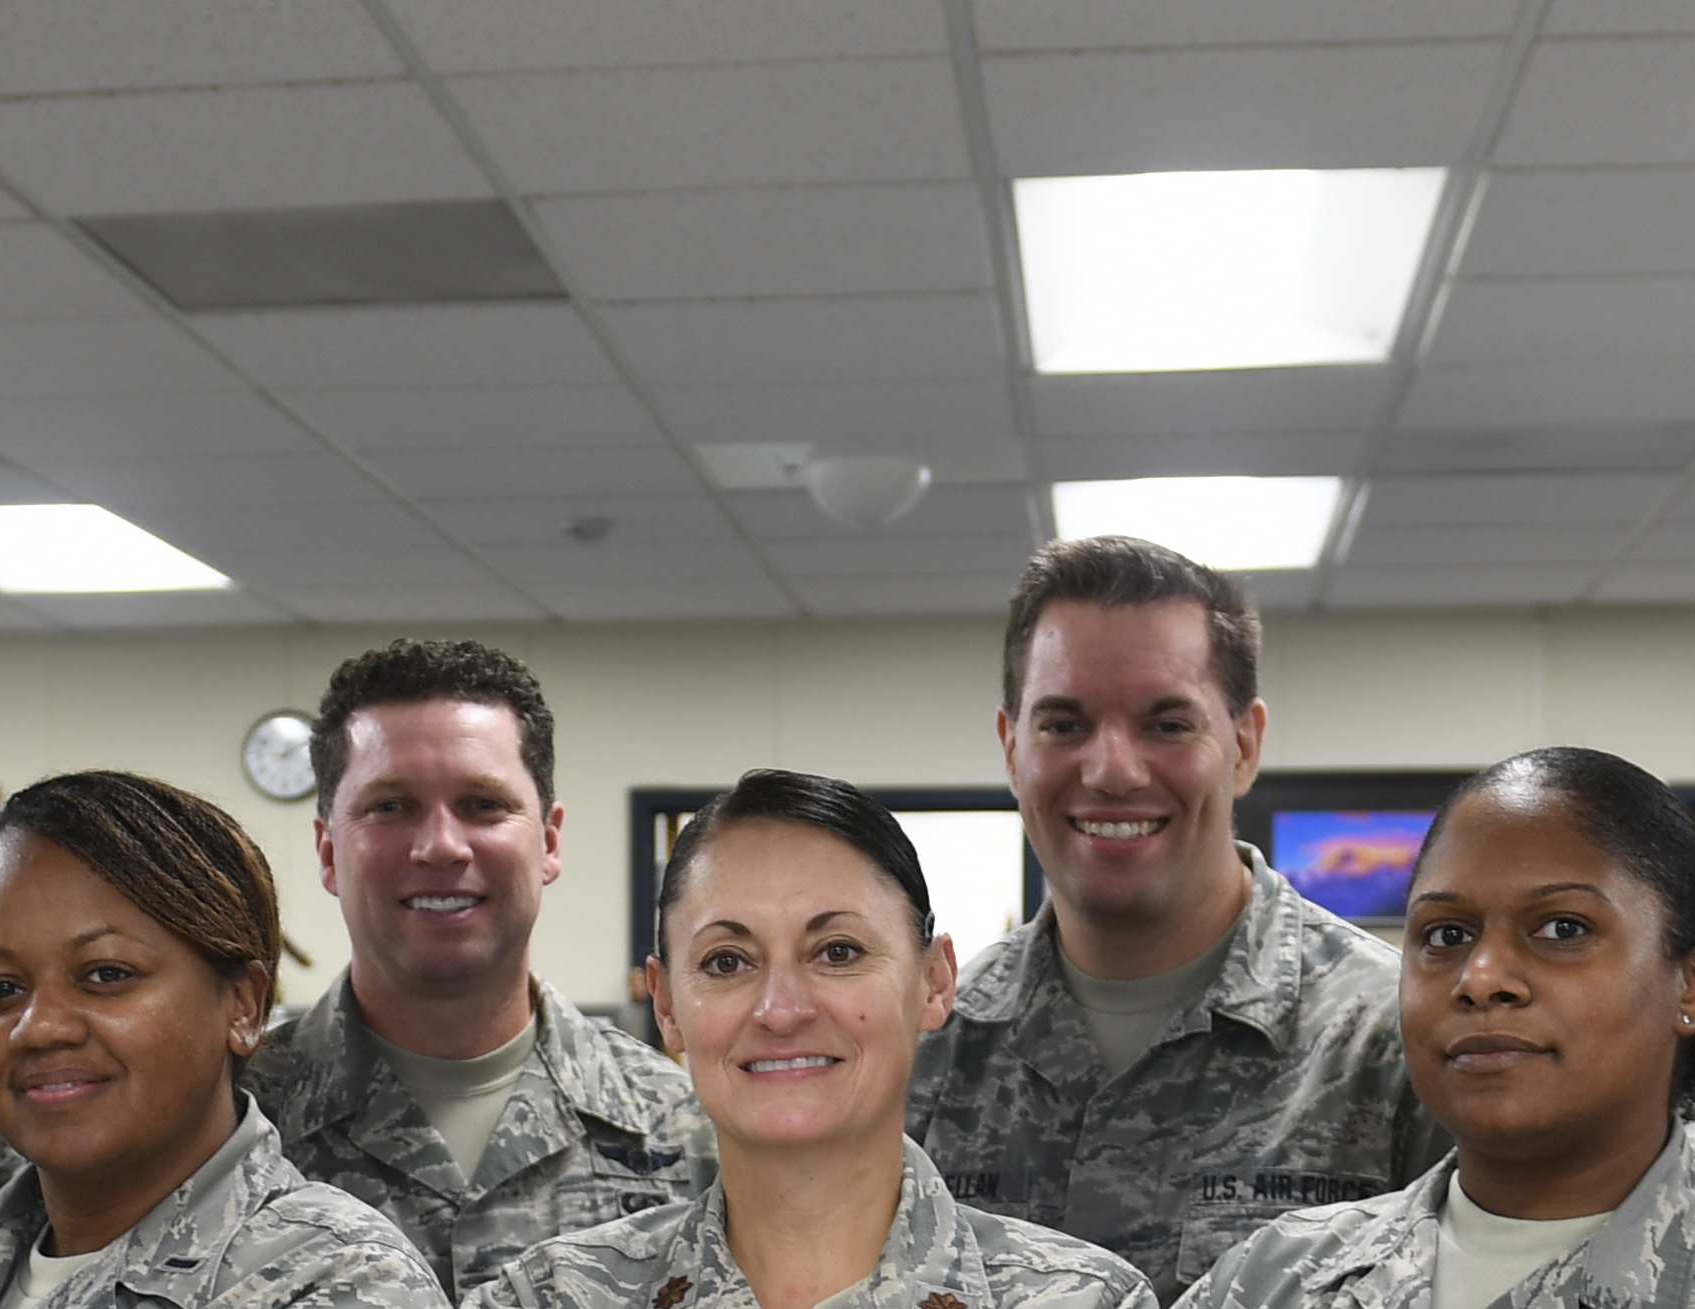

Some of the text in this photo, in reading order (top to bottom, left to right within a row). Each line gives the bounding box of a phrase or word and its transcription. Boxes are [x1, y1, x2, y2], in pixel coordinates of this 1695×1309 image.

[1203, 1174, 1378, 1204] U.S. AIR FORCE
